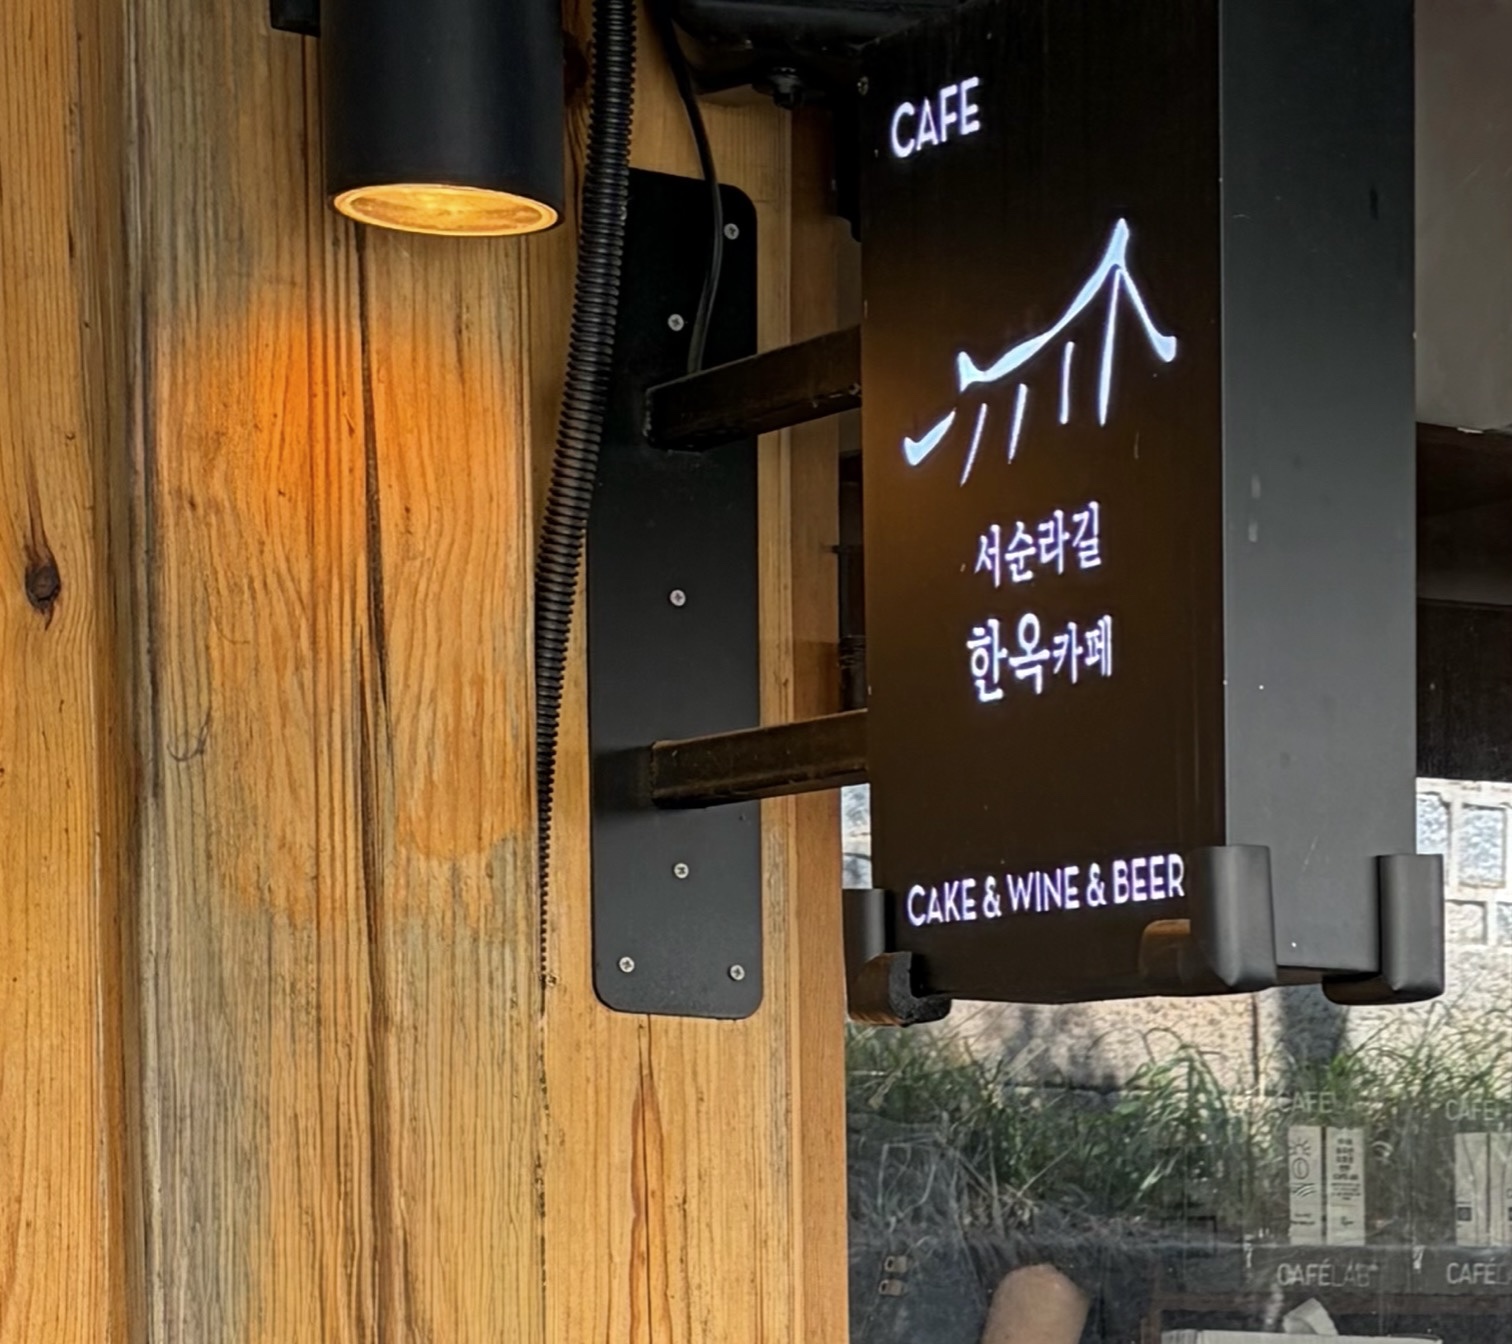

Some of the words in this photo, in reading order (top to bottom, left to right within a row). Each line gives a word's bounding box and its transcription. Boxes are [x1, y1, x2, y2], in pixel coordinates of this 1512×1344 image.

[891, 76, 981, 158] CAFE
[974, 500, 1102, 588] 서순라길
[965, 612, 1113, 703] 한옥카페
[907, 877, 978, 927] CAKE
[982, 875, 1003, 919] &
[1006, 865, 1081, 913] WINE
[1086, 862, 1108, 908] &
[1112, 853, 1186, 905] BEER
